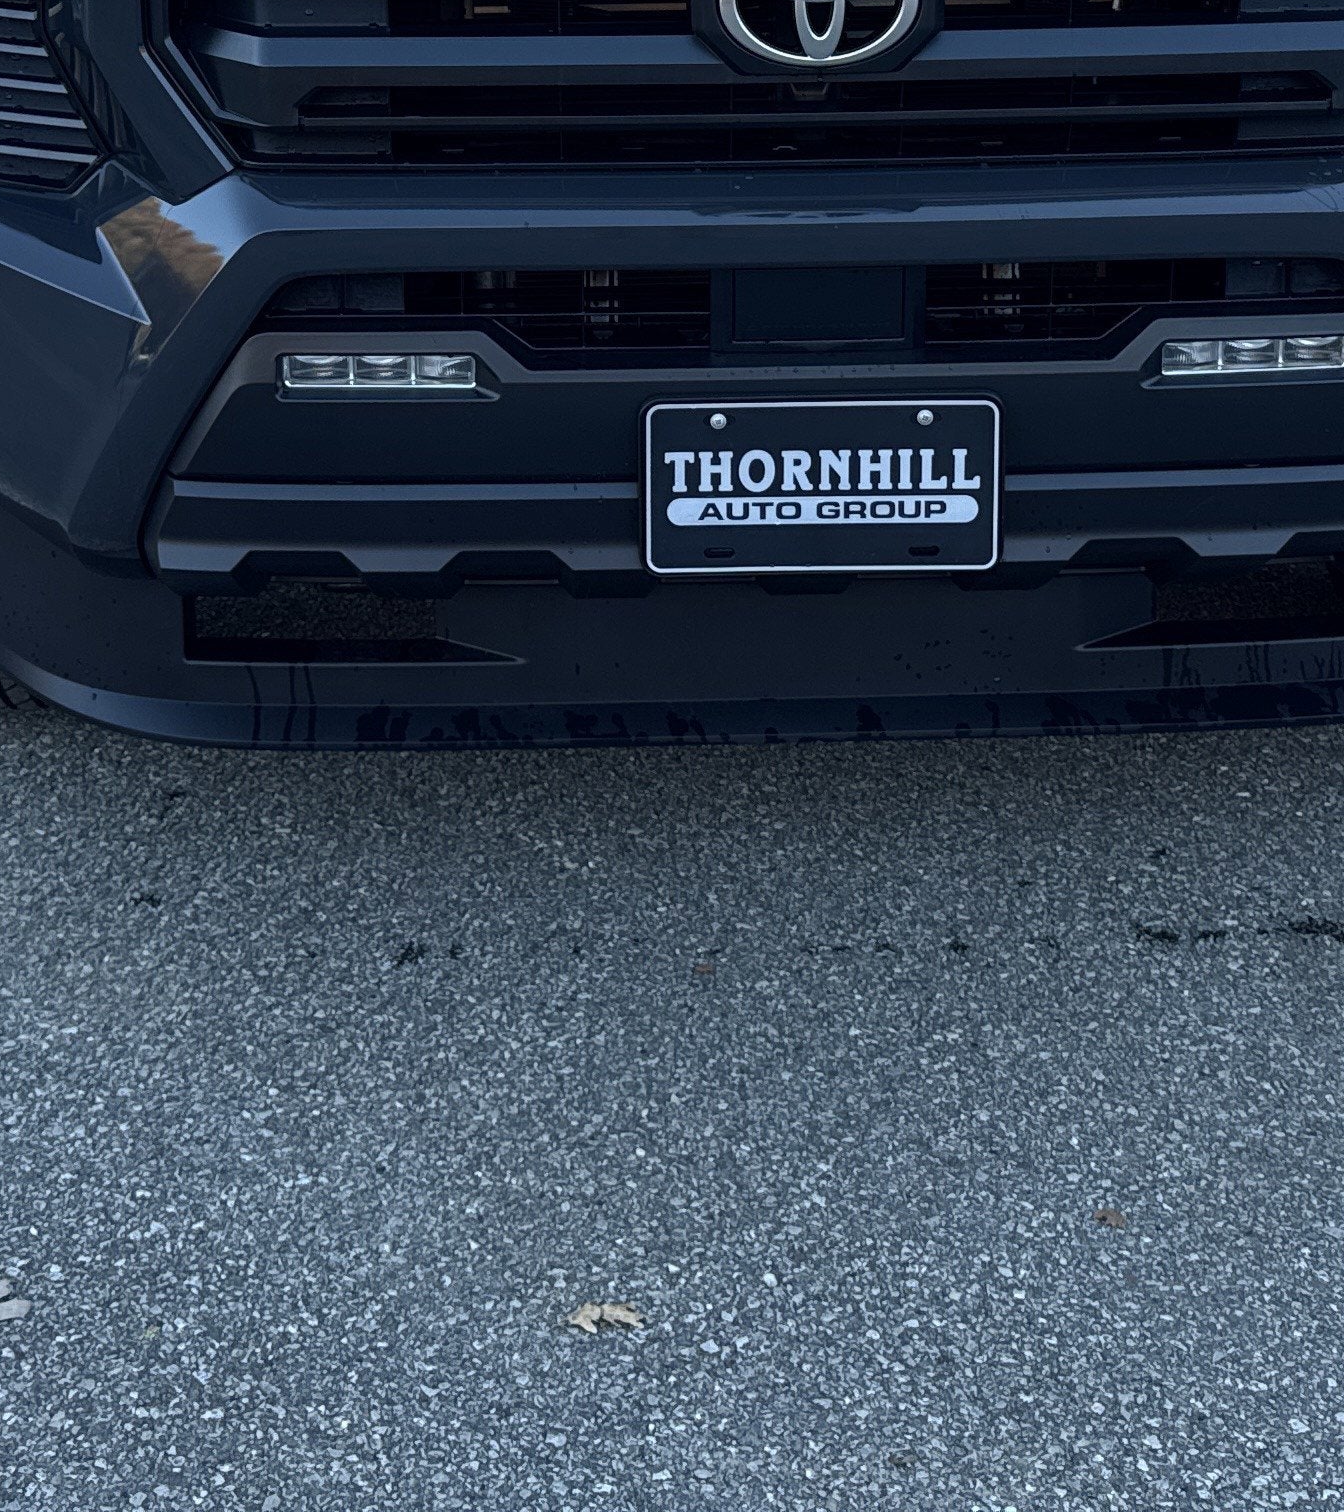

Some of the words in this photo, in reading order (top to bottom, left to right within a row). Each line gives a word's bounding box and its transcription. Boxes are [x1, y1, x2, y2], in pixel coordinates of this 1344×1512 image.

[664, 448, 981, 493] THORNHILL
[698, 501, 802, 521] AUTO
[816, 500, 947, 519] GROUP
